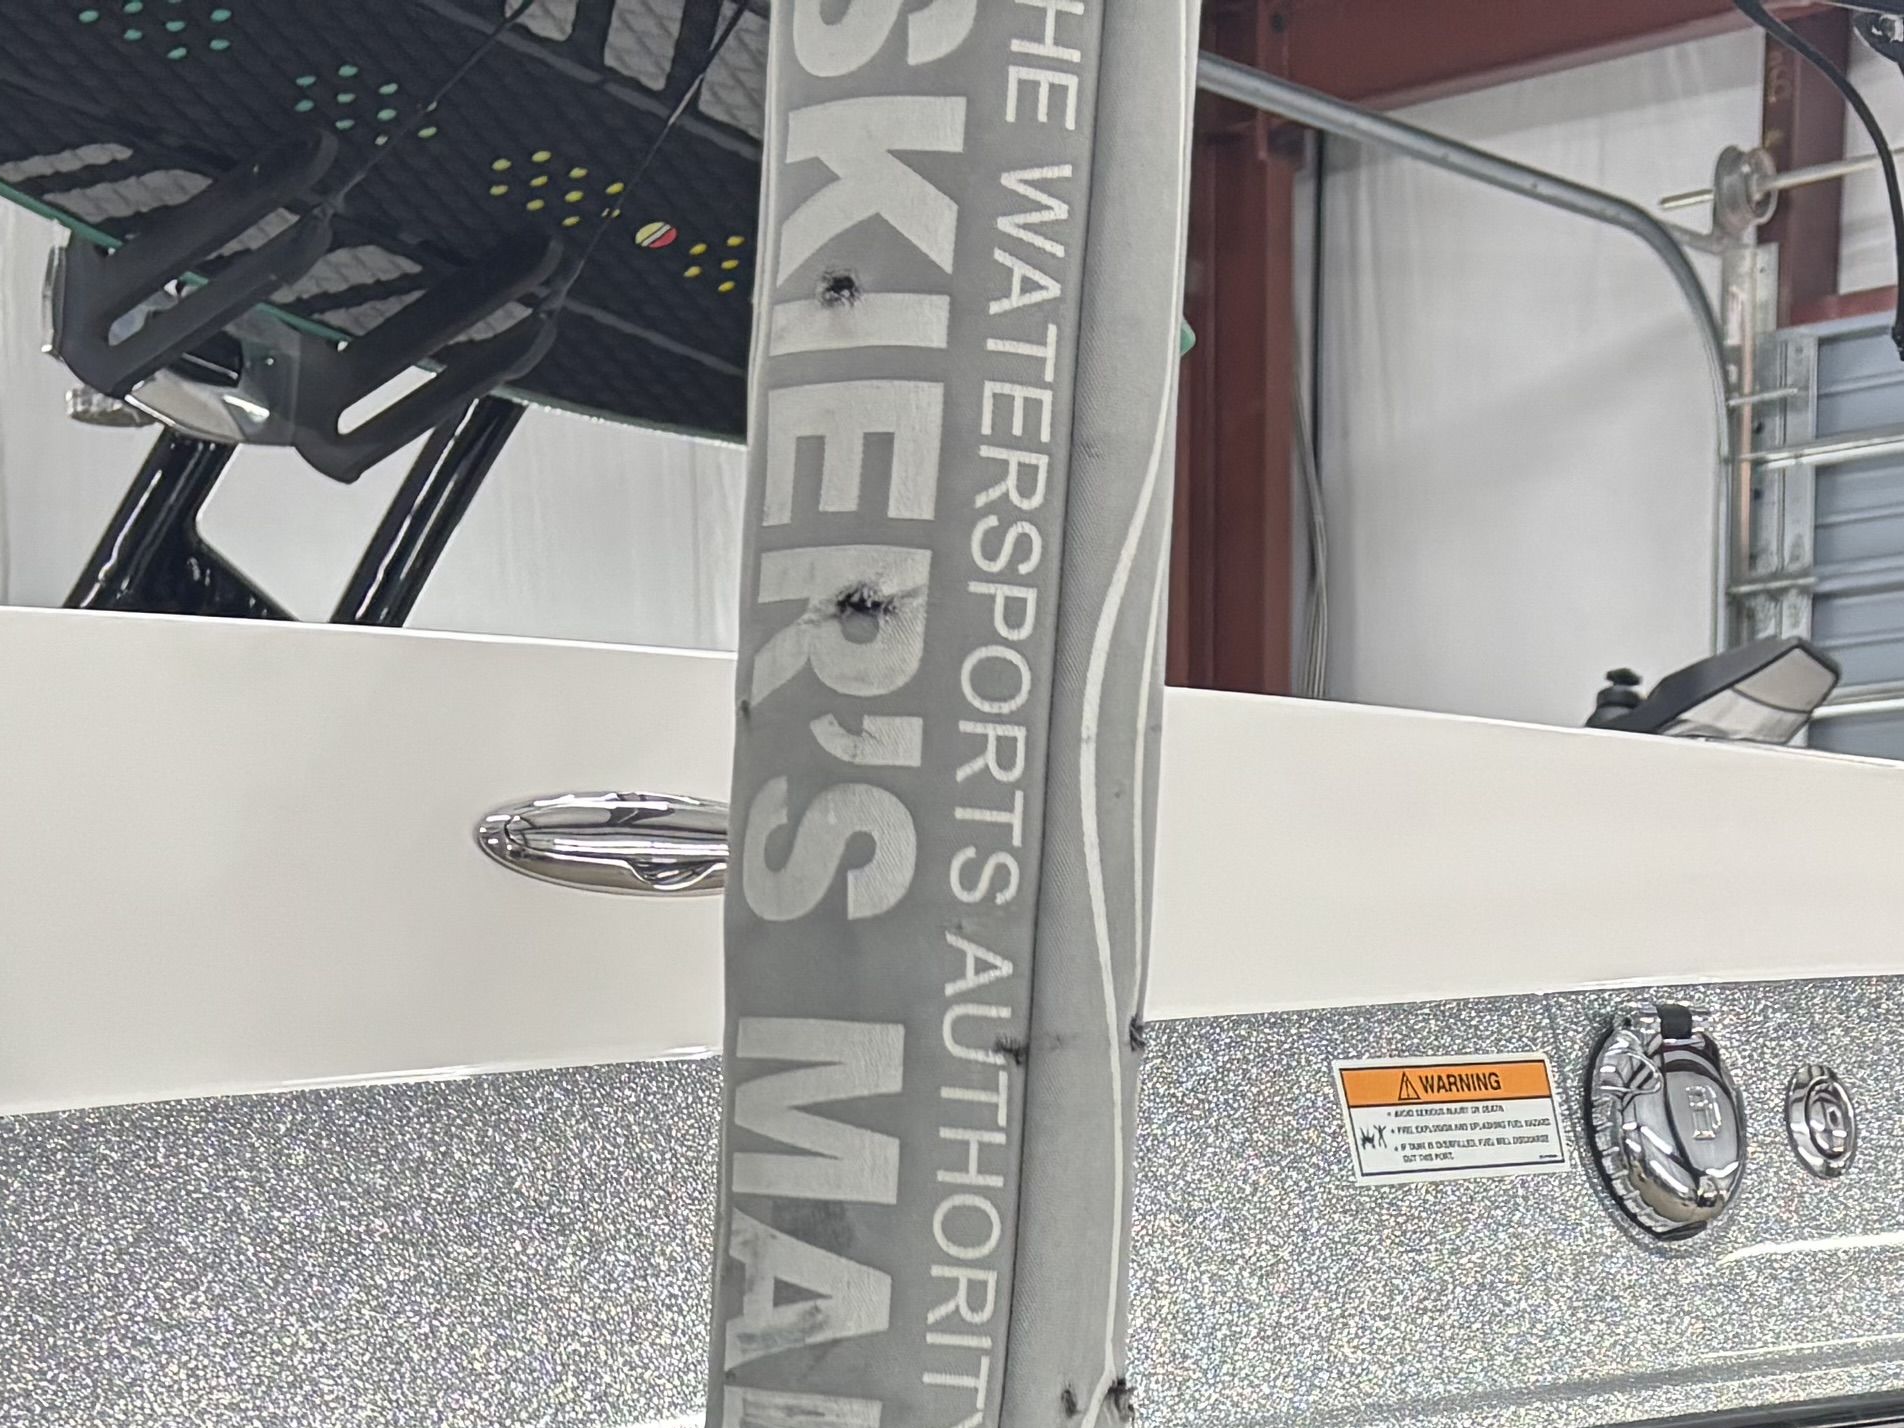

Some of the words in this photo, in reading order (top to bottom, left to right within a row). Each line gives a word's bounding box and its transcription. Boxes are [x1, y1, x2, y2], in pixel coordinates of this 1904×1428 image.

[1005, 0, 1085, 130] HE
[944, 162, 1073, 906] WATERSPORTS
[1418, 1071, 1502, 1096] WARNING
